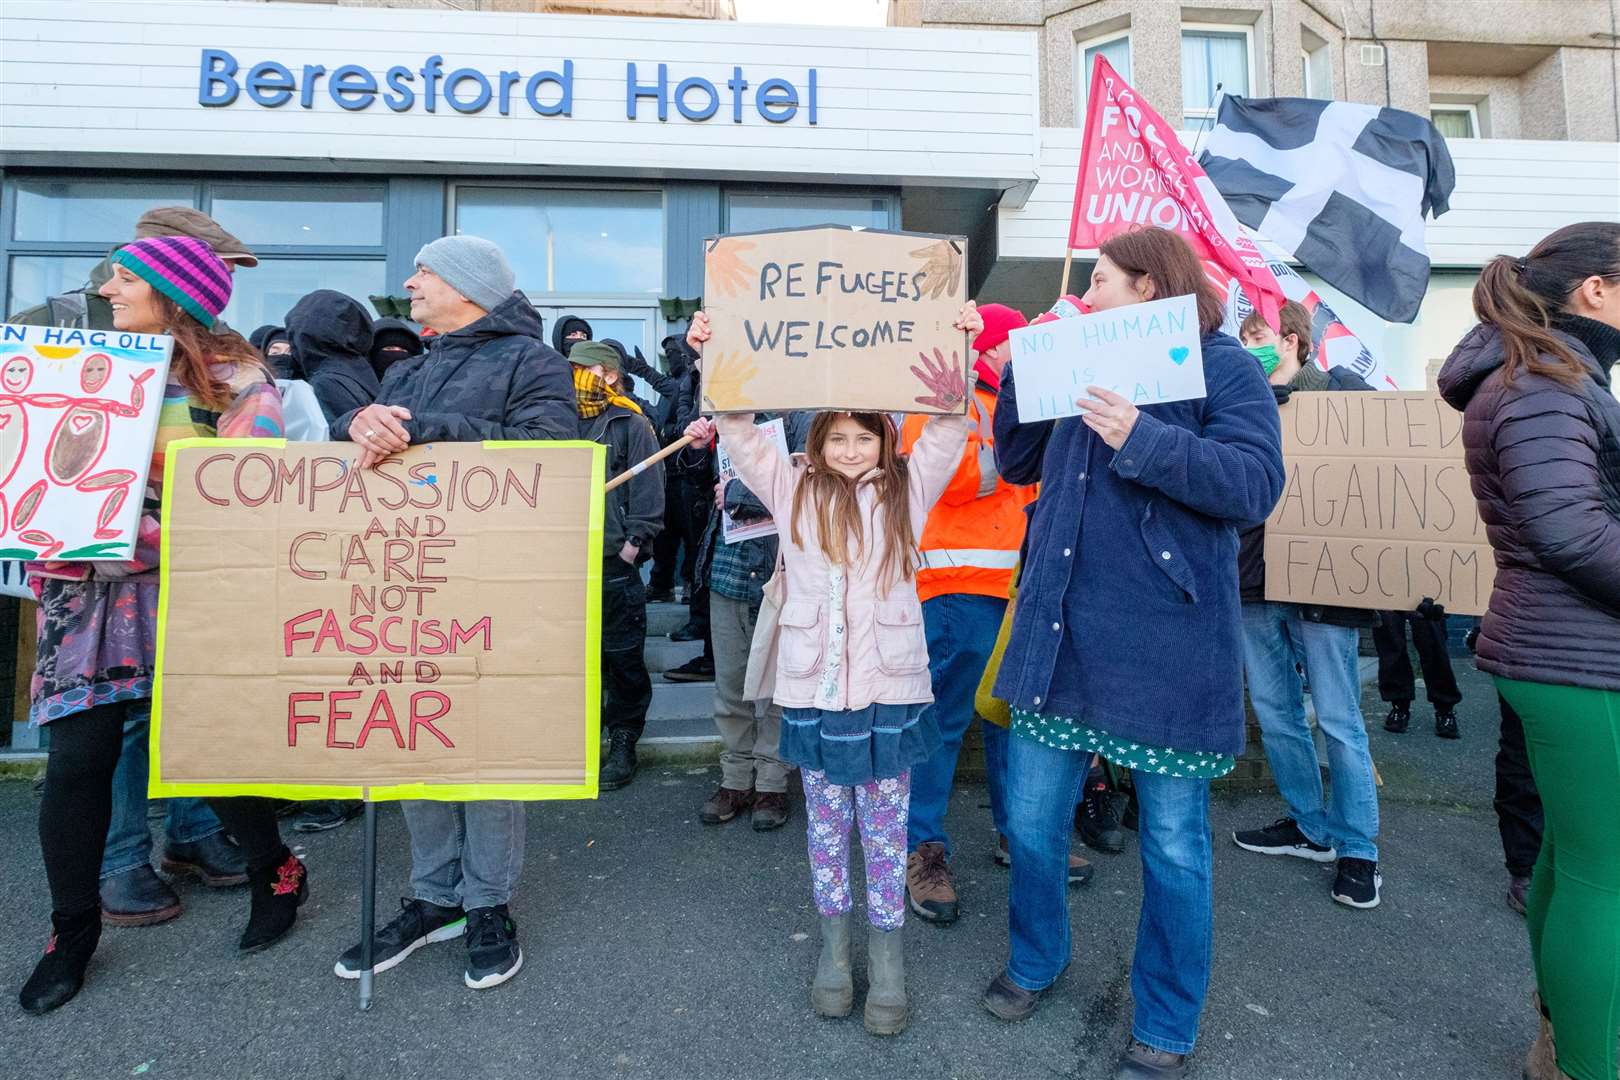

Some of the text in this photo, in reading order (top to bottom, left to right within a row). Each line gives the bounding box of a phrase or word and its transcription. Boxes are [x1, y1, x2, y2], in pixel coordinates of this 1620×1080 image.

[199, 48, 818, 125] Beresford Hotel
[1097, 141, 1145, 163] AND
[44, 329, 107, 347] HAG
[119, 333, 164, 351] OLL
[744, 320, 915, 358] WELCOME
[1021, 306, 1187, 355] NO HUMAN
[1072, 368, 1097, 385] IS
[1039, 380, 1171, 417] ILLAL
[1295, 397, 1463, 449] UNITED
[195, 452, 542, 513] COMPASSION
[364, 514, 447, 540] AND
[289, 532, 456, 583] CARE
[1287, 541, 1478, 606] FASCISM
[350, 584, 437, 616] NOT
[283, 609, 492, 657] FASCISM
[348, 661, 441, 686] AND
[288, 689, 456, 751] FEAR
